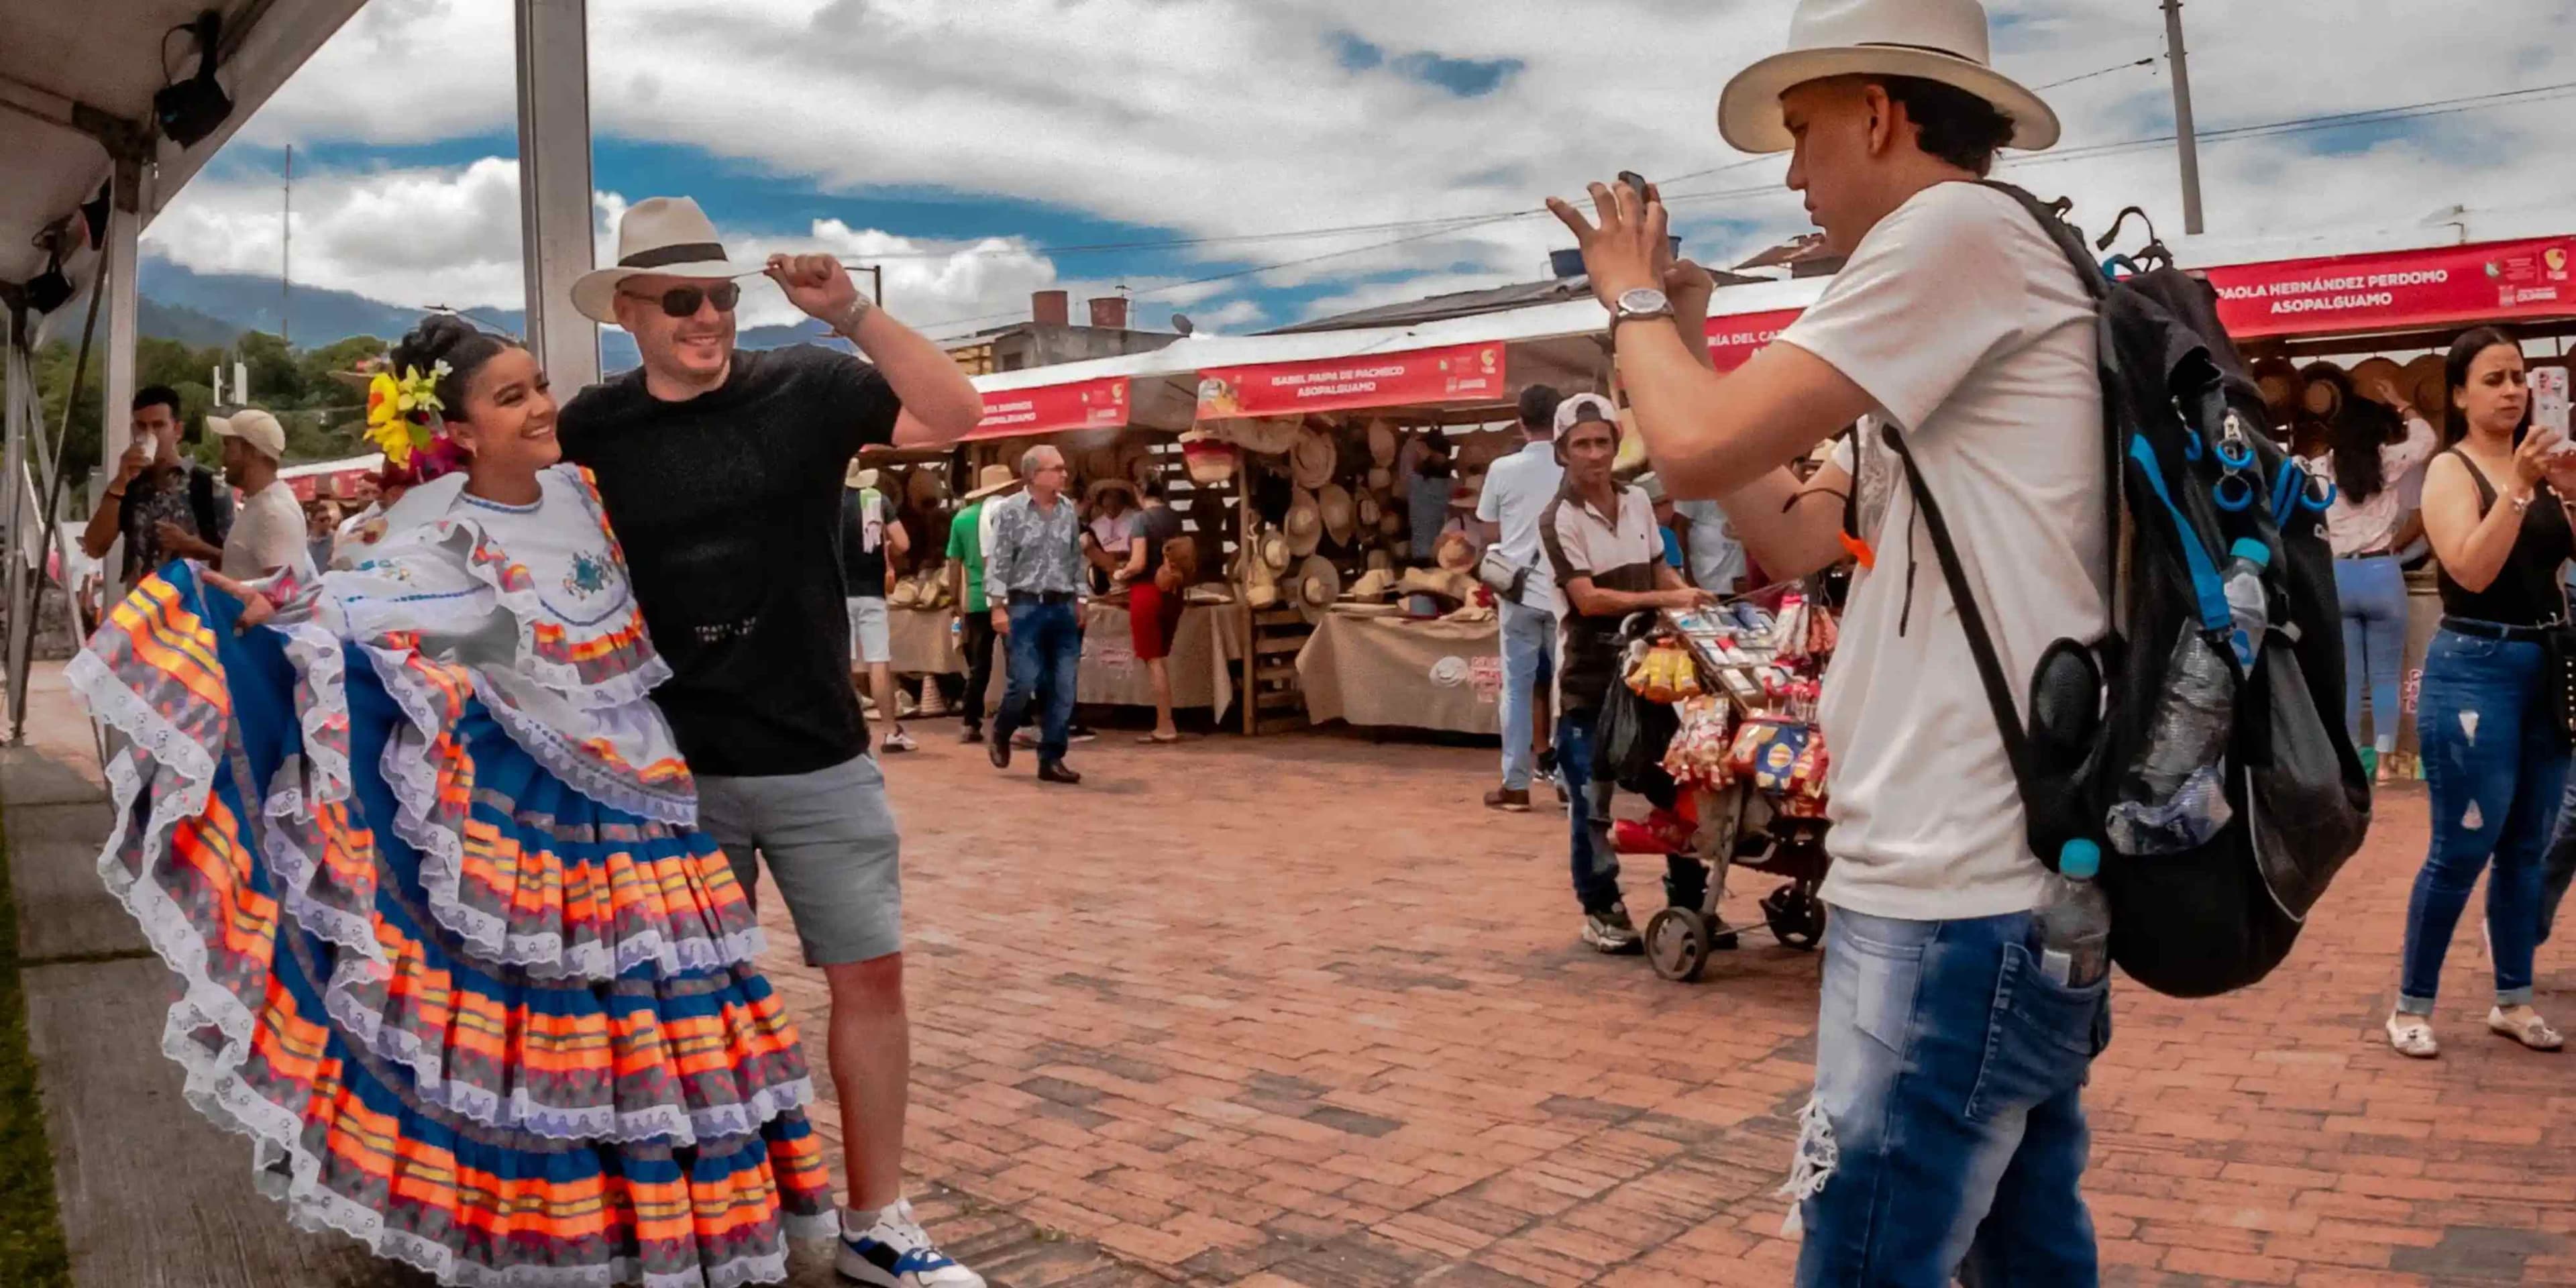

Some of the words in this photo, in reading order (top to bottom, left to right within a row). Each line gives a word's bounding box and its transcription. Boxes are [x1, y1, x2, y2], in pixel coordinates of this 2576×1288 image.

[2216, 284, 2267, 301] PAOLA
[2269, 276, 2365, 297] HERNÁNDEZ
[2368, 269, 2448, 288] PERDOMO
[2271, 291, 2393, 315] ASOPALGUAMO
[1297, 382, 1376, 397] ASOPALGUAMO
